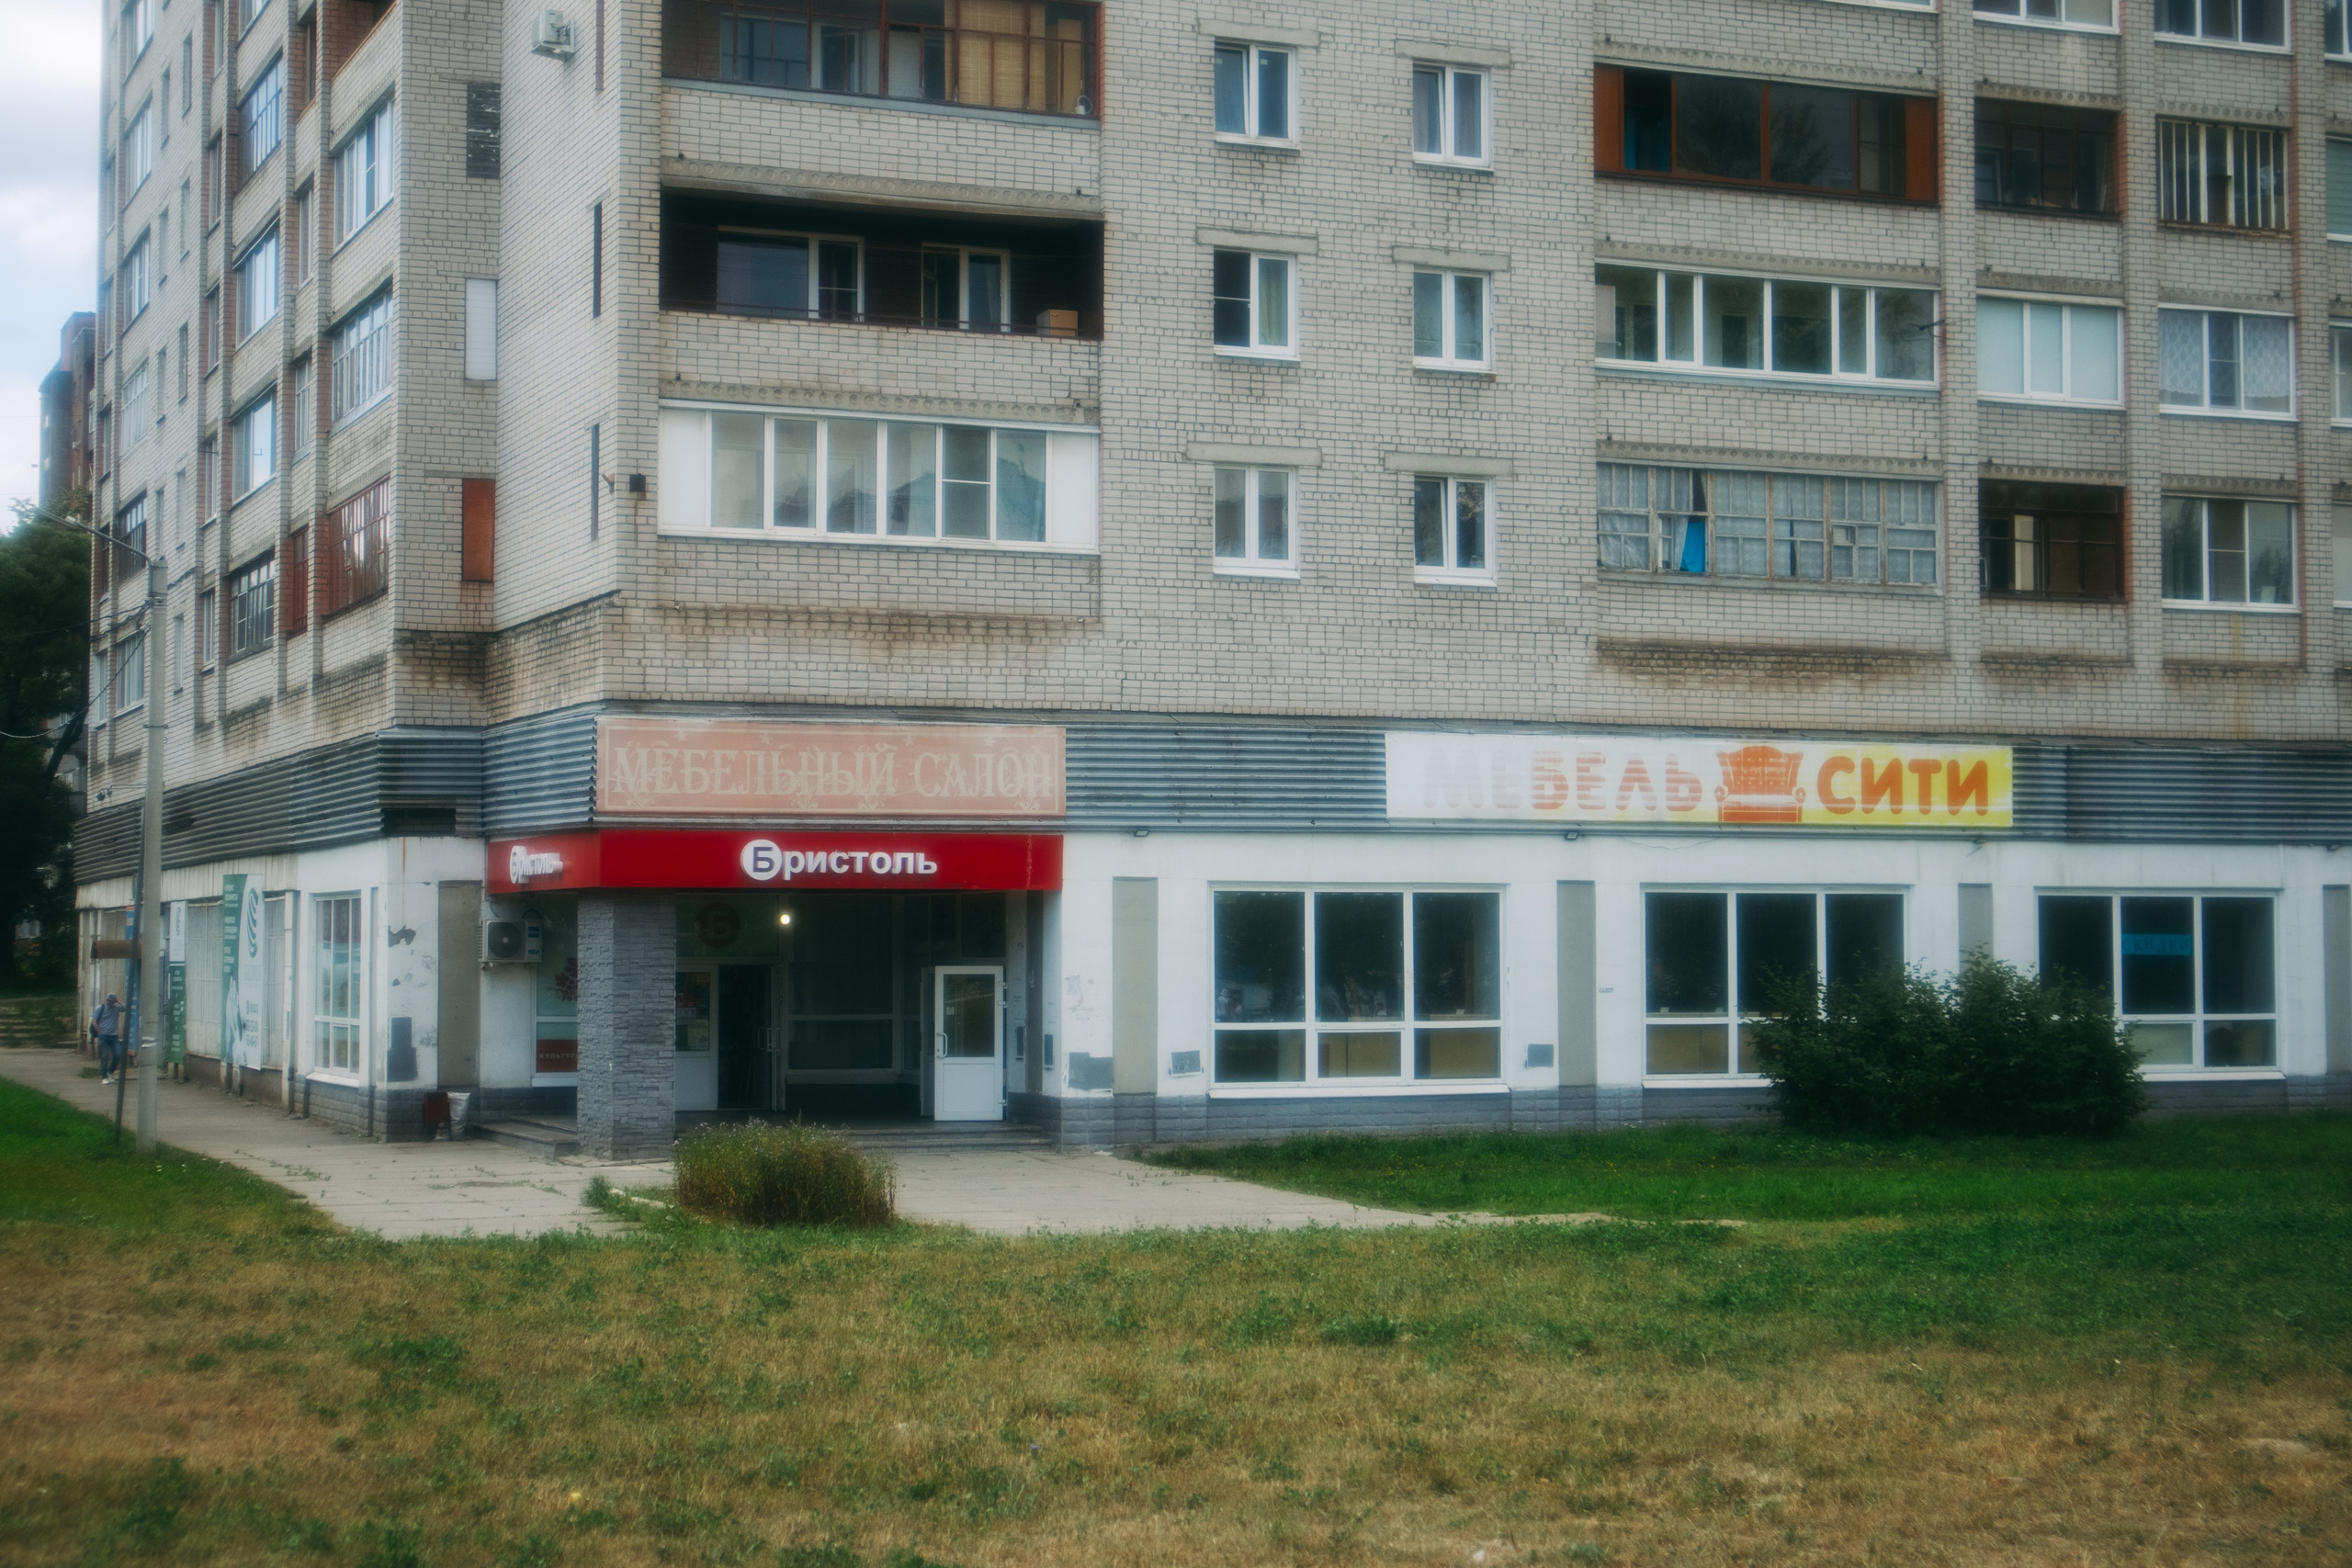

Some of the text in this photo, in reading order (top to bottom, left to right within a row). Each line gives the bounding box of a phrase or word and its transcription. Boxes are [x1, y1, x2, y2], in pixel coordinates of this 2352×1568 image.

[614, 740, 1052, 798] МЕБЕЛЬНЫЙ САЛОН
[1421, 747, 1989, 818] МЕБЕЛЬ СИТИ
[510, 845, 559, 884] Бристоль
[740, 839, 938, 881] Бристоль
[2122, 937, 2188, 953] СКИДКИ
[539, 1052, 577, 1060] КУЛЬТУР
